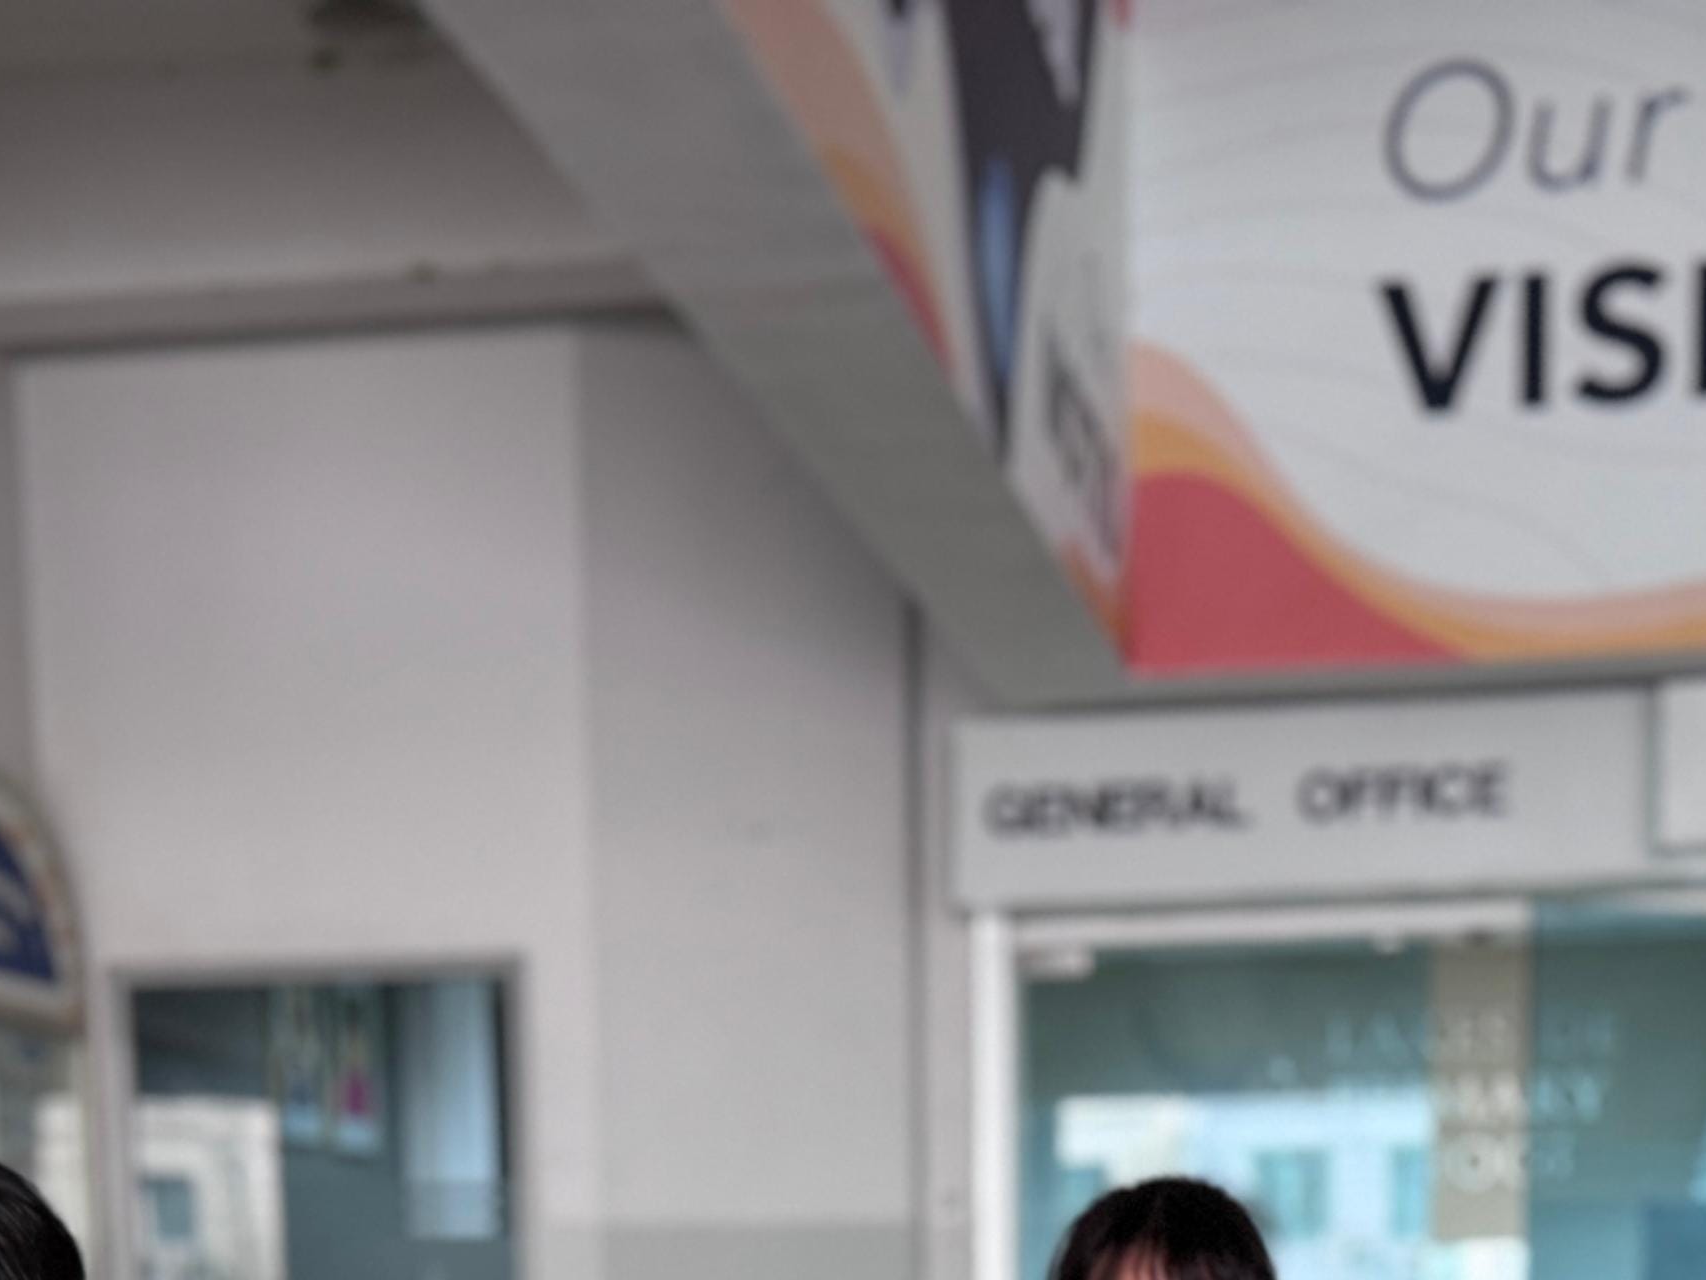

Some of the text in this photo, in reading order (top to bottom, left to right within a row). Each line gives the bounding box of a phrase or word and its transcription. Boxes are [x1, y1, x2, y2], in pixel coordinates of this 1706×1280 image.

[1382, 55, 1688, 203] Our
[989, 762, 1507, 840] GENERAL OFFICE
